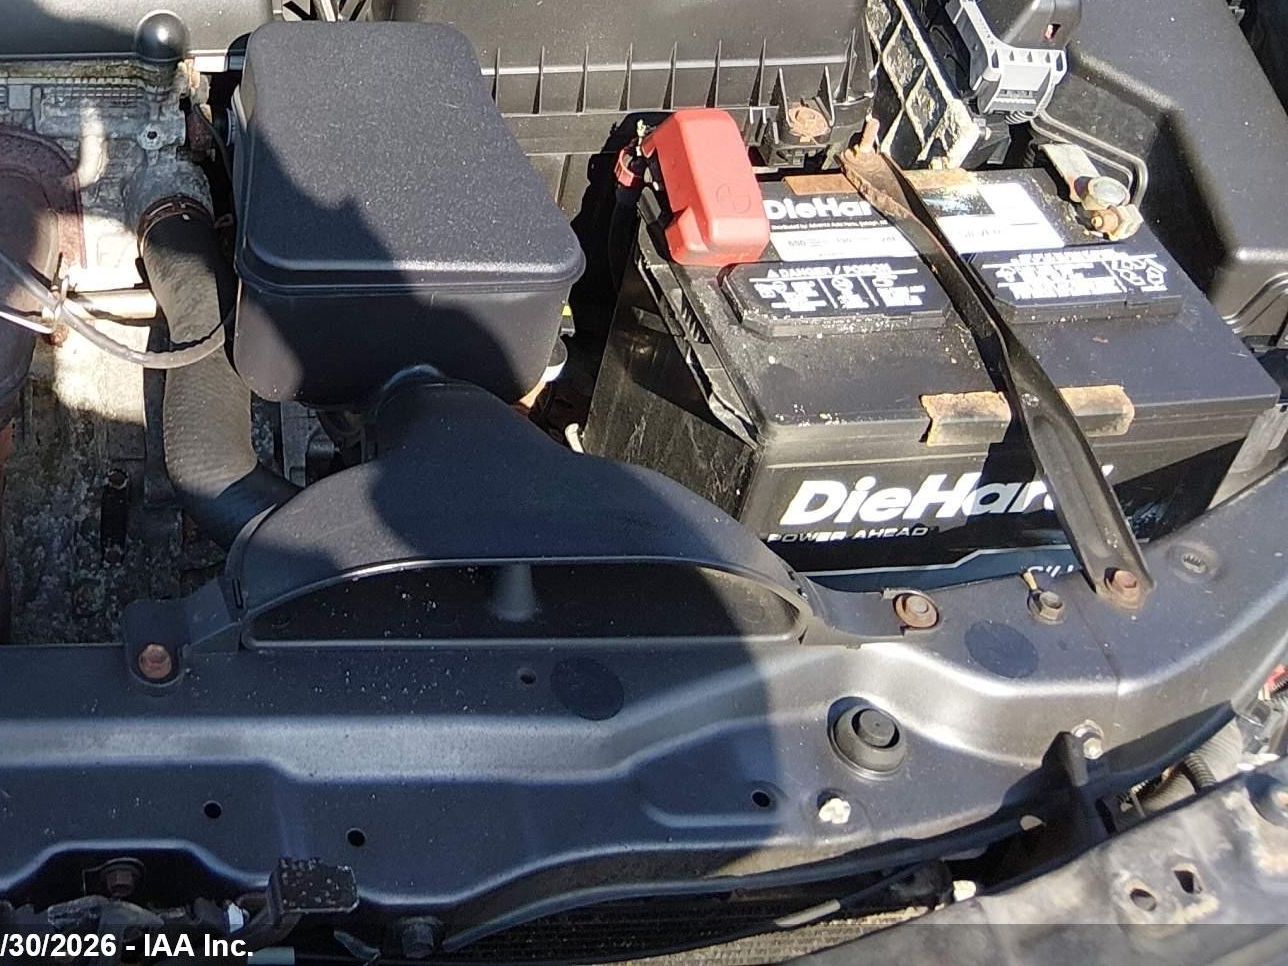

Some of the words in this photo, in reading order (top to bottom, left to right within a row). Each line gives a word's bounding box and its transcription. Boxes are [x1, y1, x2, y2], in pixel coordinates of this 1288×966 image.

[763, 197, 873, 220] DieHar
[780, 465, 1113, 525] DieHar
[767, 530, 847, 543] POWER
[852, 527, 929, 541] AHEAD
